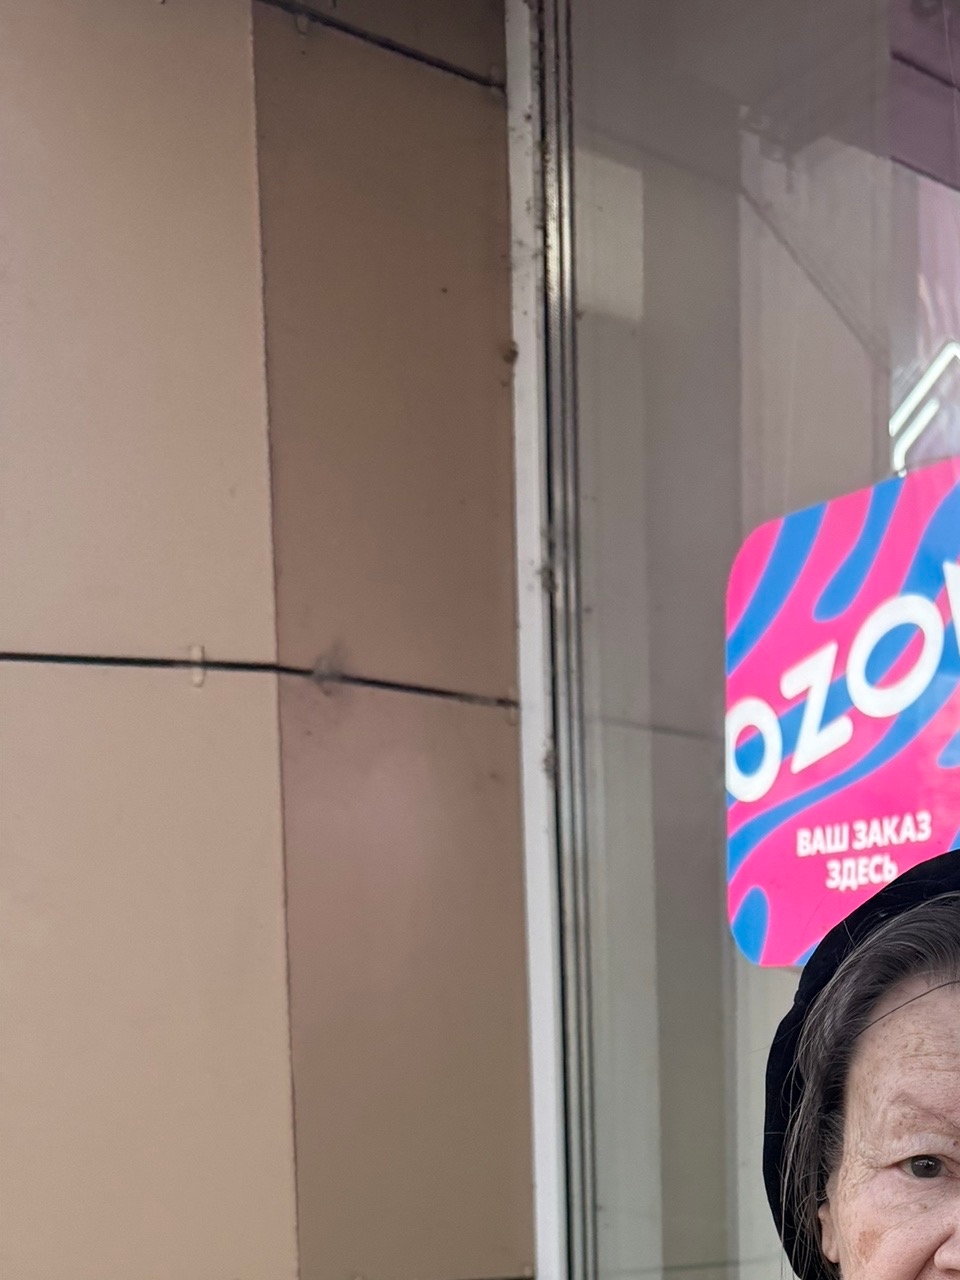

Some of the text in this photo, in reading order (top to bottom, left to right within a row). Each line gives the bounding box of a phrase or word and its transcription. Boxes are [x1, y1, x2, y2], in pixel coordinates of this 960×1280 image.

[797, 810, 932, 857] ВАШ ЗАКАЗ
[825, 854, 898, 892] ЗДЕСЬ
